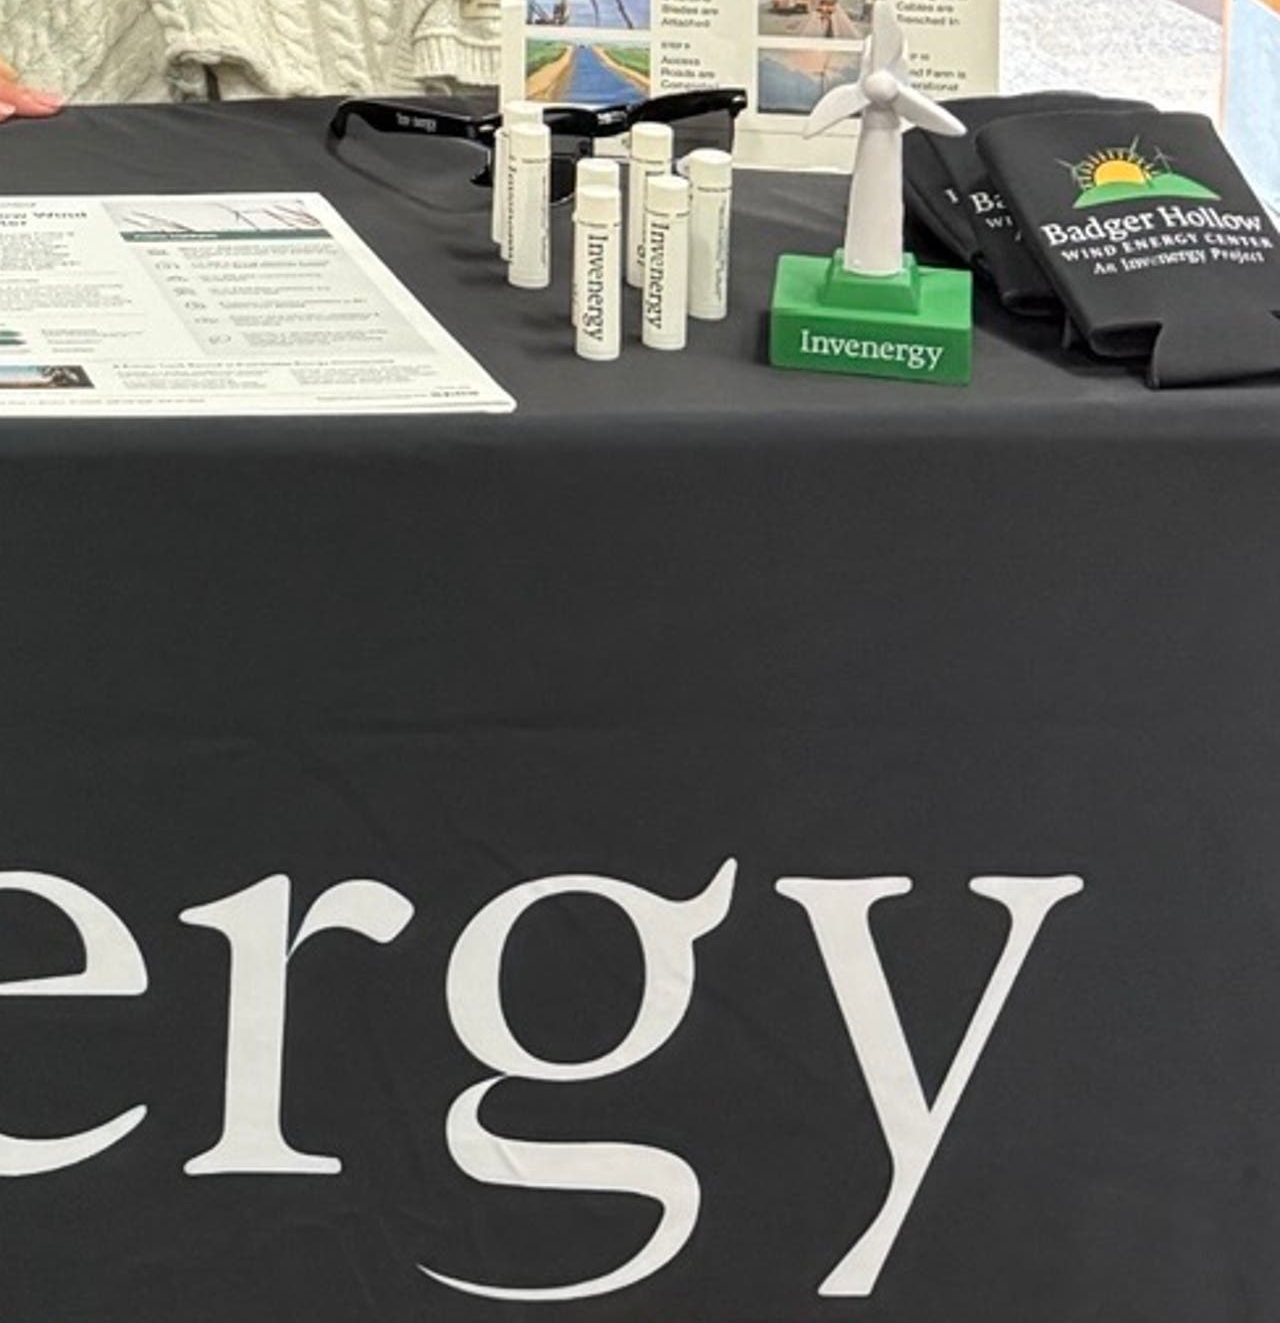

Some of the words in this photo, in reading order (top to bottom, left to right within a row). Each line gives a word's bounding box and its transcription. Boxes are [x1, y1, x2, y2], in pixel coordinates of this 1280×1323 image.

[1040, 211, 1155, 247] Badger
[1156, 206, 1262, 233] Hollow
[1060, 245, 1117, 262] WIND
[1122, 231, 1199, 254] ENERGY
[1203, 230, 1274, 249] CENTER
[646, 221, 670, 330] Invenergy
[1092, 261, 1118, 275] An
[1211, 247, 1265, 265] Project
[582, 233, 609, 342] Invenergy
[800, 328, 944, 371] Invenergy
